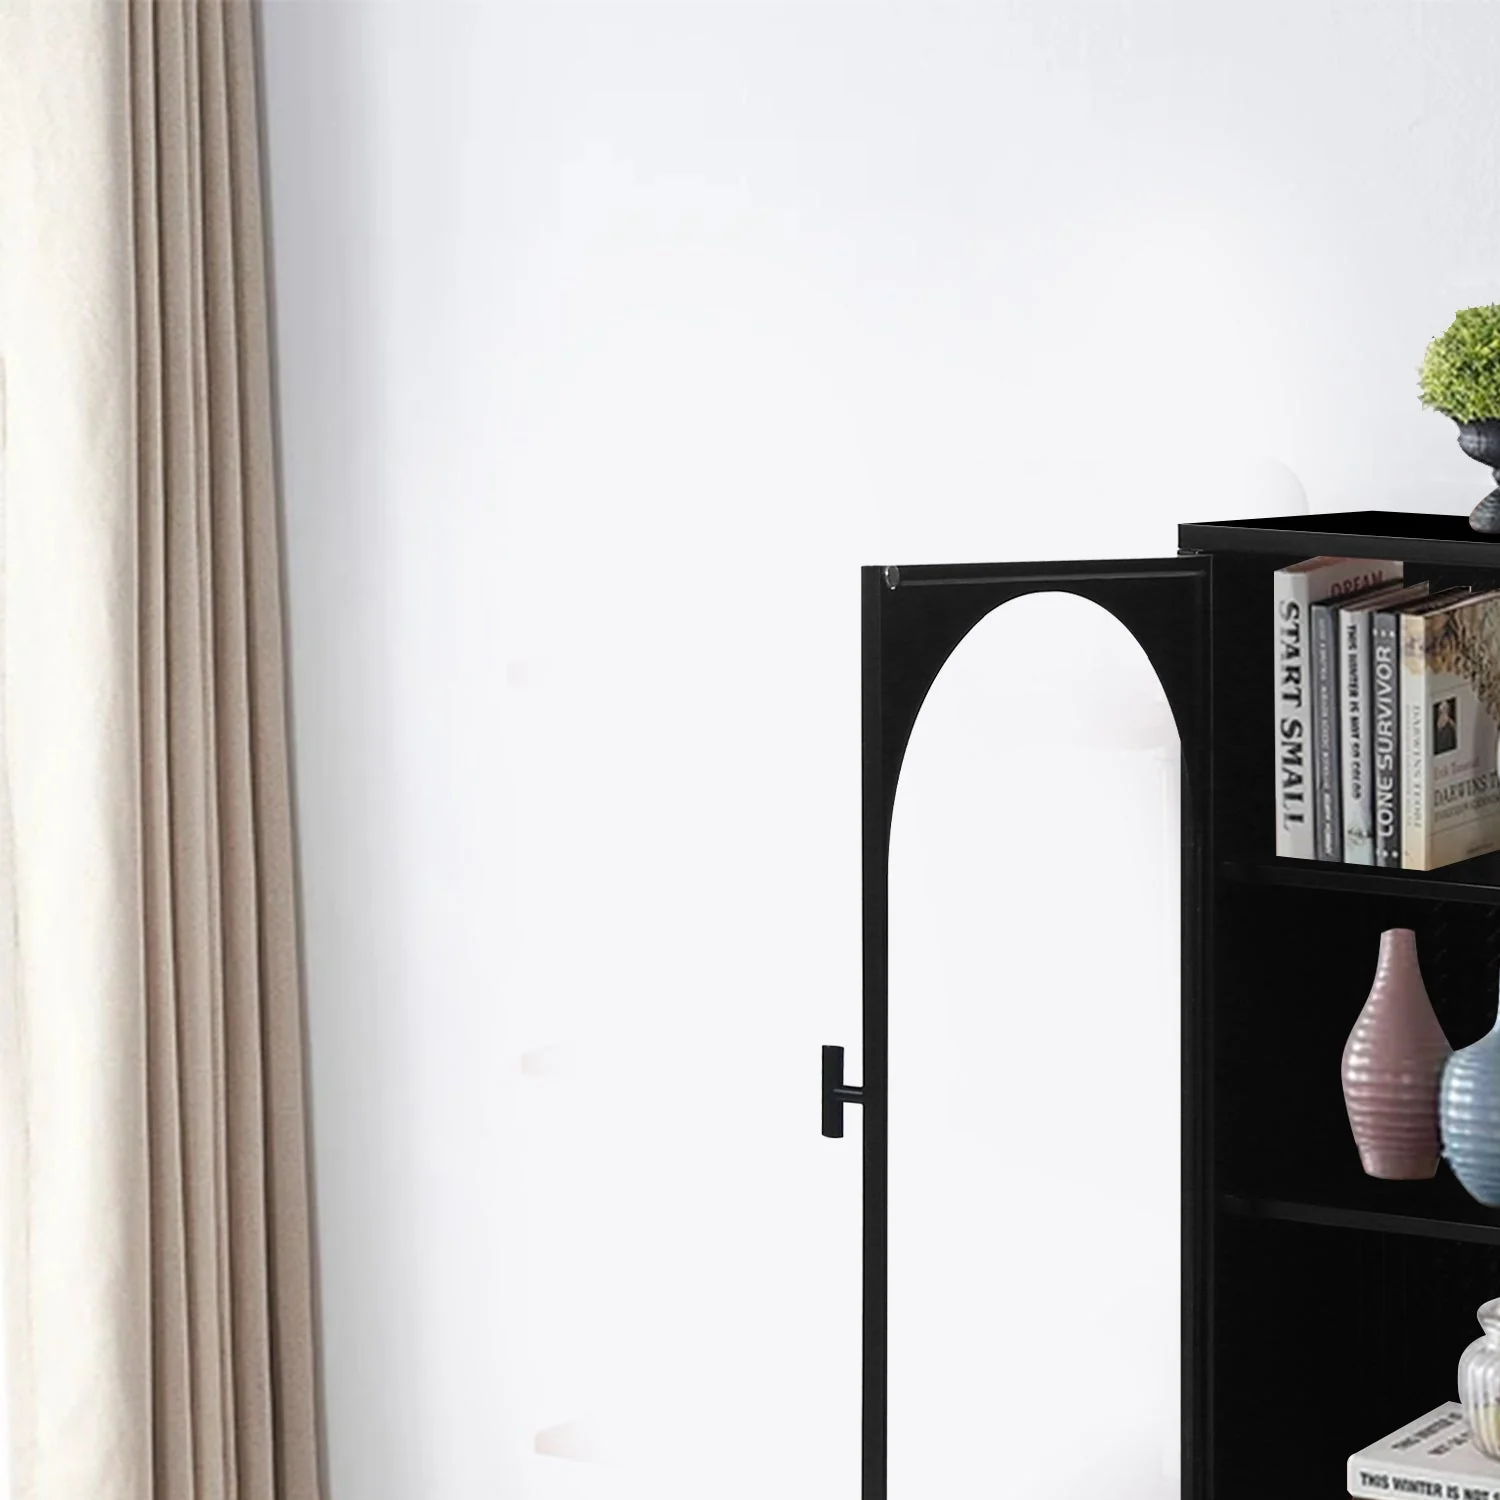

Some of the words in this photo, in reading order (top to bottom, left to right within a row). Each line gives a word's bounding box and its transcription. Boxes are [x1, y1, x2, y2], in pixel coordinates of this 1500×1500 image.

[1279, 600, 1301, 709] START
[1375, 646, 1394, 773] SURVIVOR
[1279, 718, 1305, 832] SMALL
[1375, 782, 1394, 838] LONE
[1359, 1471, 1389, 1489] THIS
[1392, 1475, 1443, 1498] WINTER
[1446, 1485, 1460, 1500] IS
